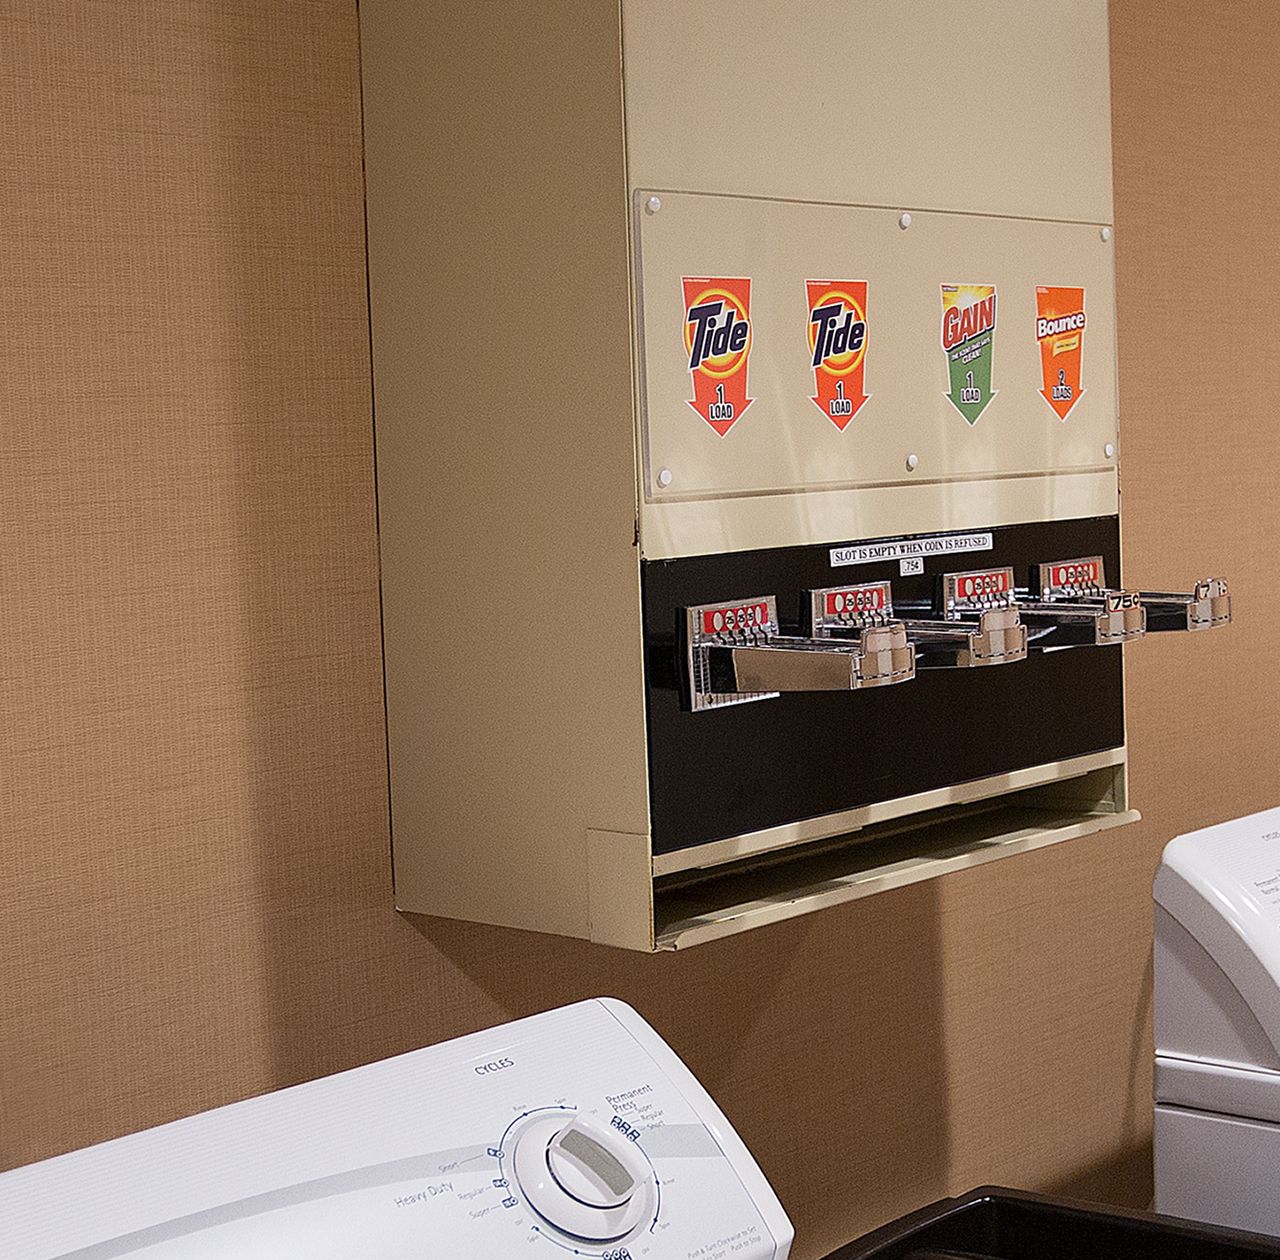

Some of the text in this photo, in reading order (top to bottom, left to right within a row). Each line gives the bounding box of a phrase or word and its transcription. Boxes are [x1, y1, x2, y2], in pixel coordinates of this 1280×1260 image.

[943, 295, 995, 349] GAIN
[1038, 312, 1084, 338] Bounce
[687, 300, 749, 369] Tide
[811, 302, 866, 367] Tide
[966, 371, 973, 388] 1
[1058, 369, 1065, 386] 2
[716, 385, 724, 403] 1
[836, 382, 843, 400] 1
[961, 388, 980, 402] LOAD
[710, 404, 733, 419] LOAD
[831, 401, 852, 415] LOAD
[835, 536, 987, 562] SLOT IS EMPTY WHEN COIN IS REFUSED
[474, 1057, 515, 1076] CYCLES
[605, 1084, 653, 1105] Permanent
[612, 1100, 636, 1113] Press
[393, 1181, 454, 1207] Heavy Duty
